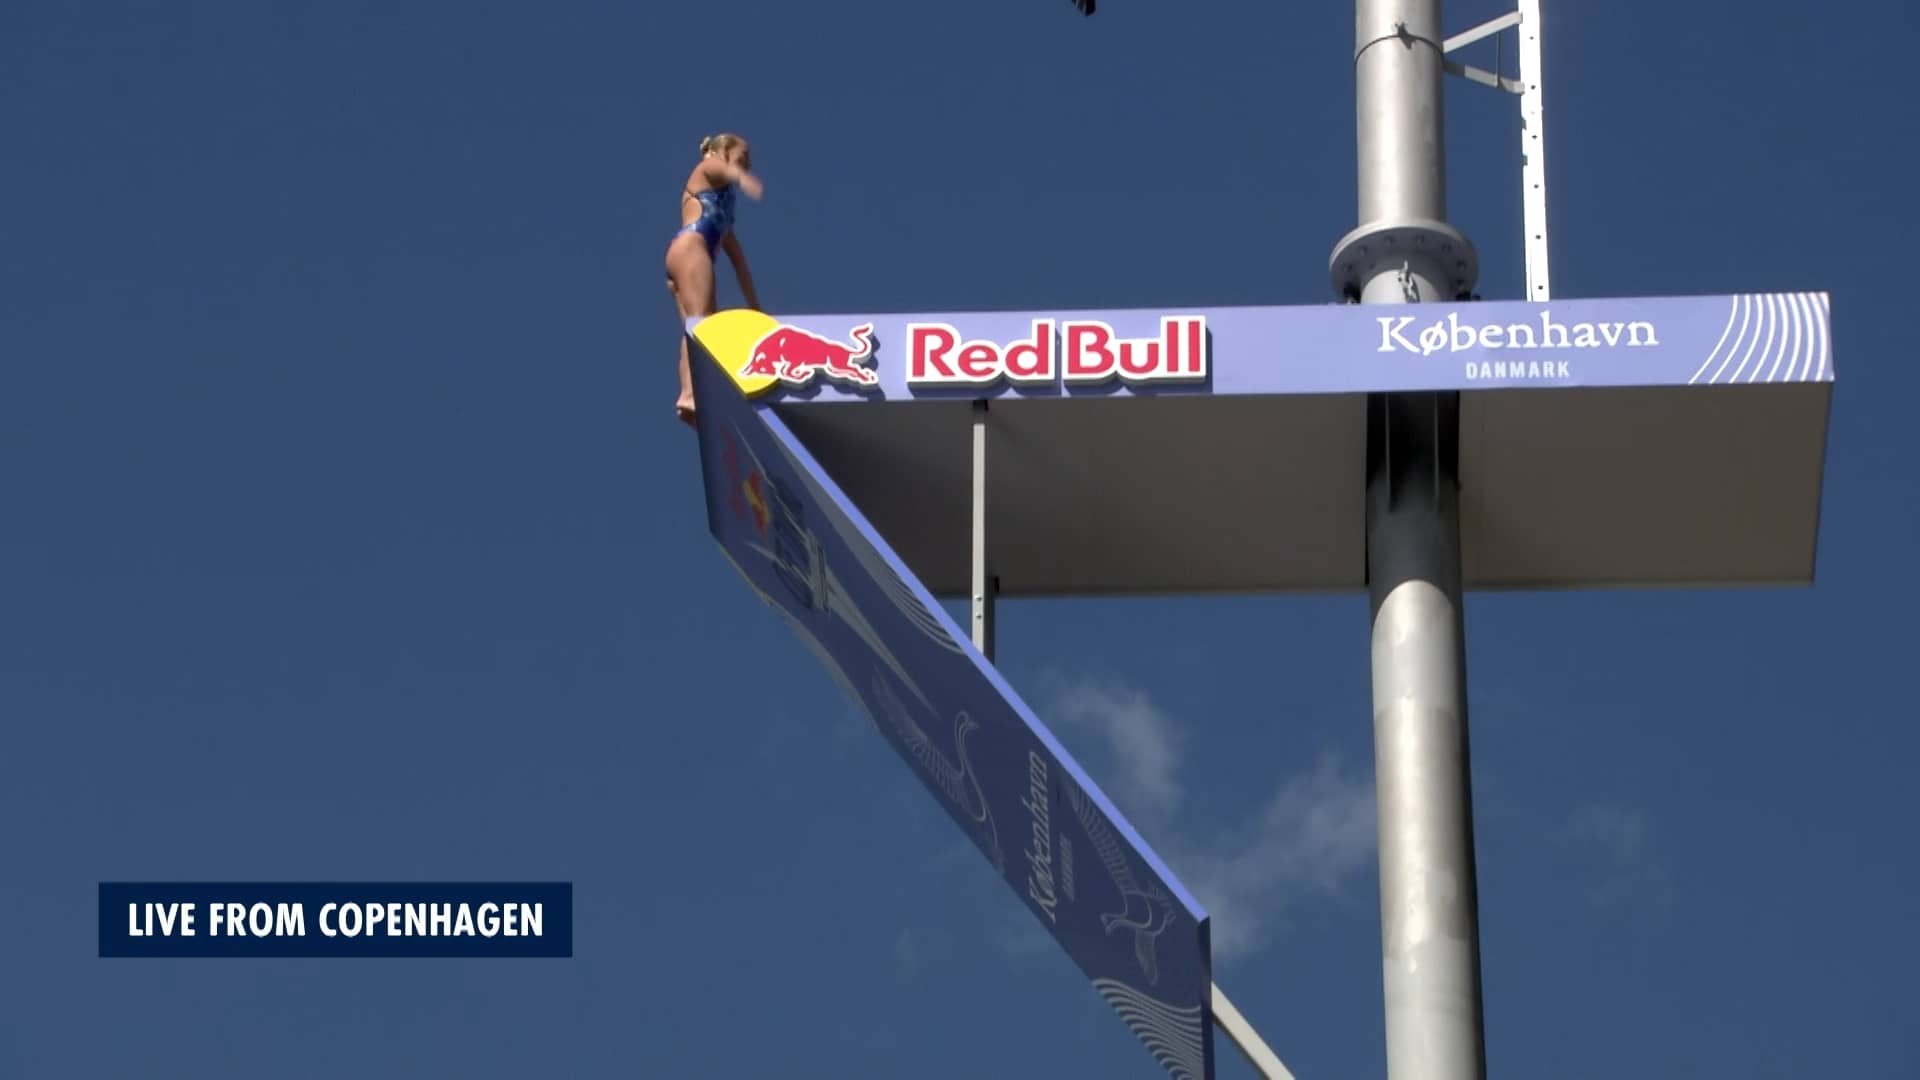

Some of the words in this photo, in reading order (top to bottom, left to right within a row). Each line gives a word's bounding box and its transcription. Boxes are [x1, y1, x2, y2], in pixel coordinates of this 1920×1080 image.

[908, 319, 1056, 381] Red
[1064, 316, 1206, 379] Bull
[1377, 311, 1659, 356] København
[1466, 361, 1570, 380] DANMARK
